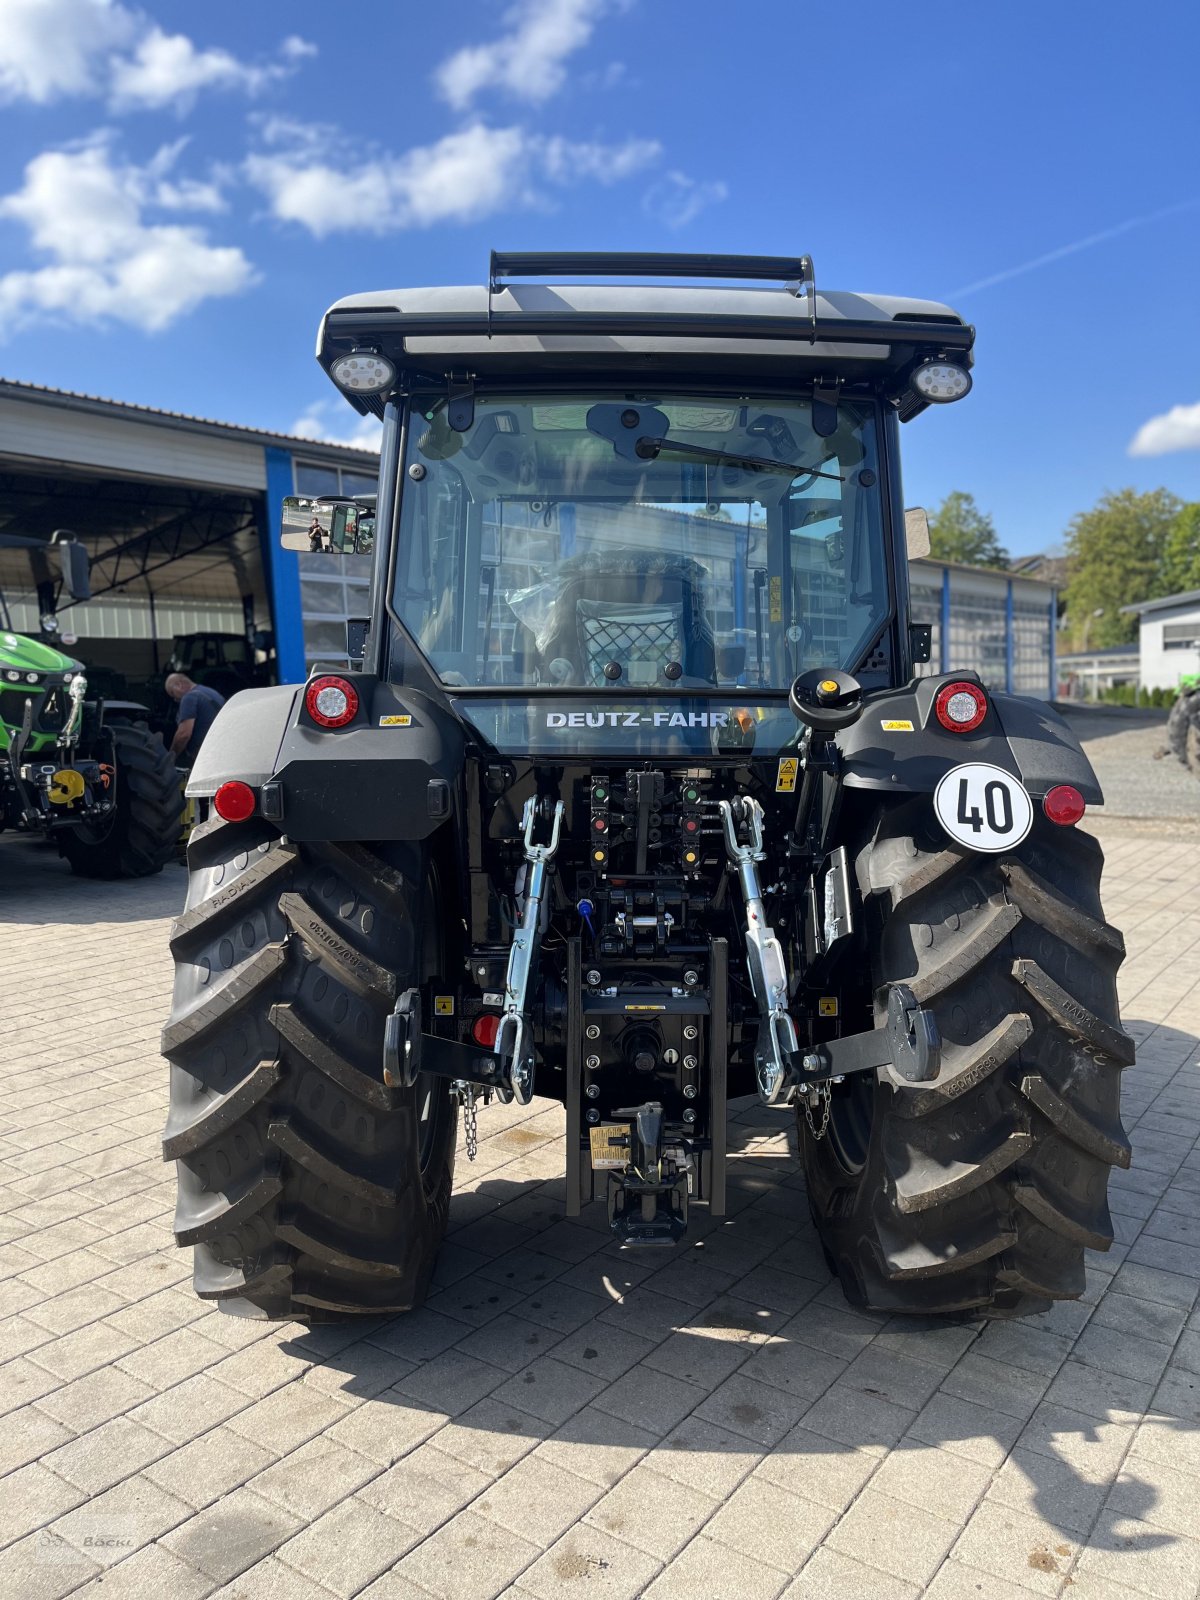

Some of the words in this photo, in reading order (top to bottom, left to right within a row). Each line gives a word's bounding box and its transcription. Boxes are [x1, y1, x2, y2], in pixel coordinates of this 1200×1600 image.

[546, 712, 728, 728] DEUTZ-FAHR
[957, 778, 1014, 835] 40
[212, 877, 256, 908] RADIAL
